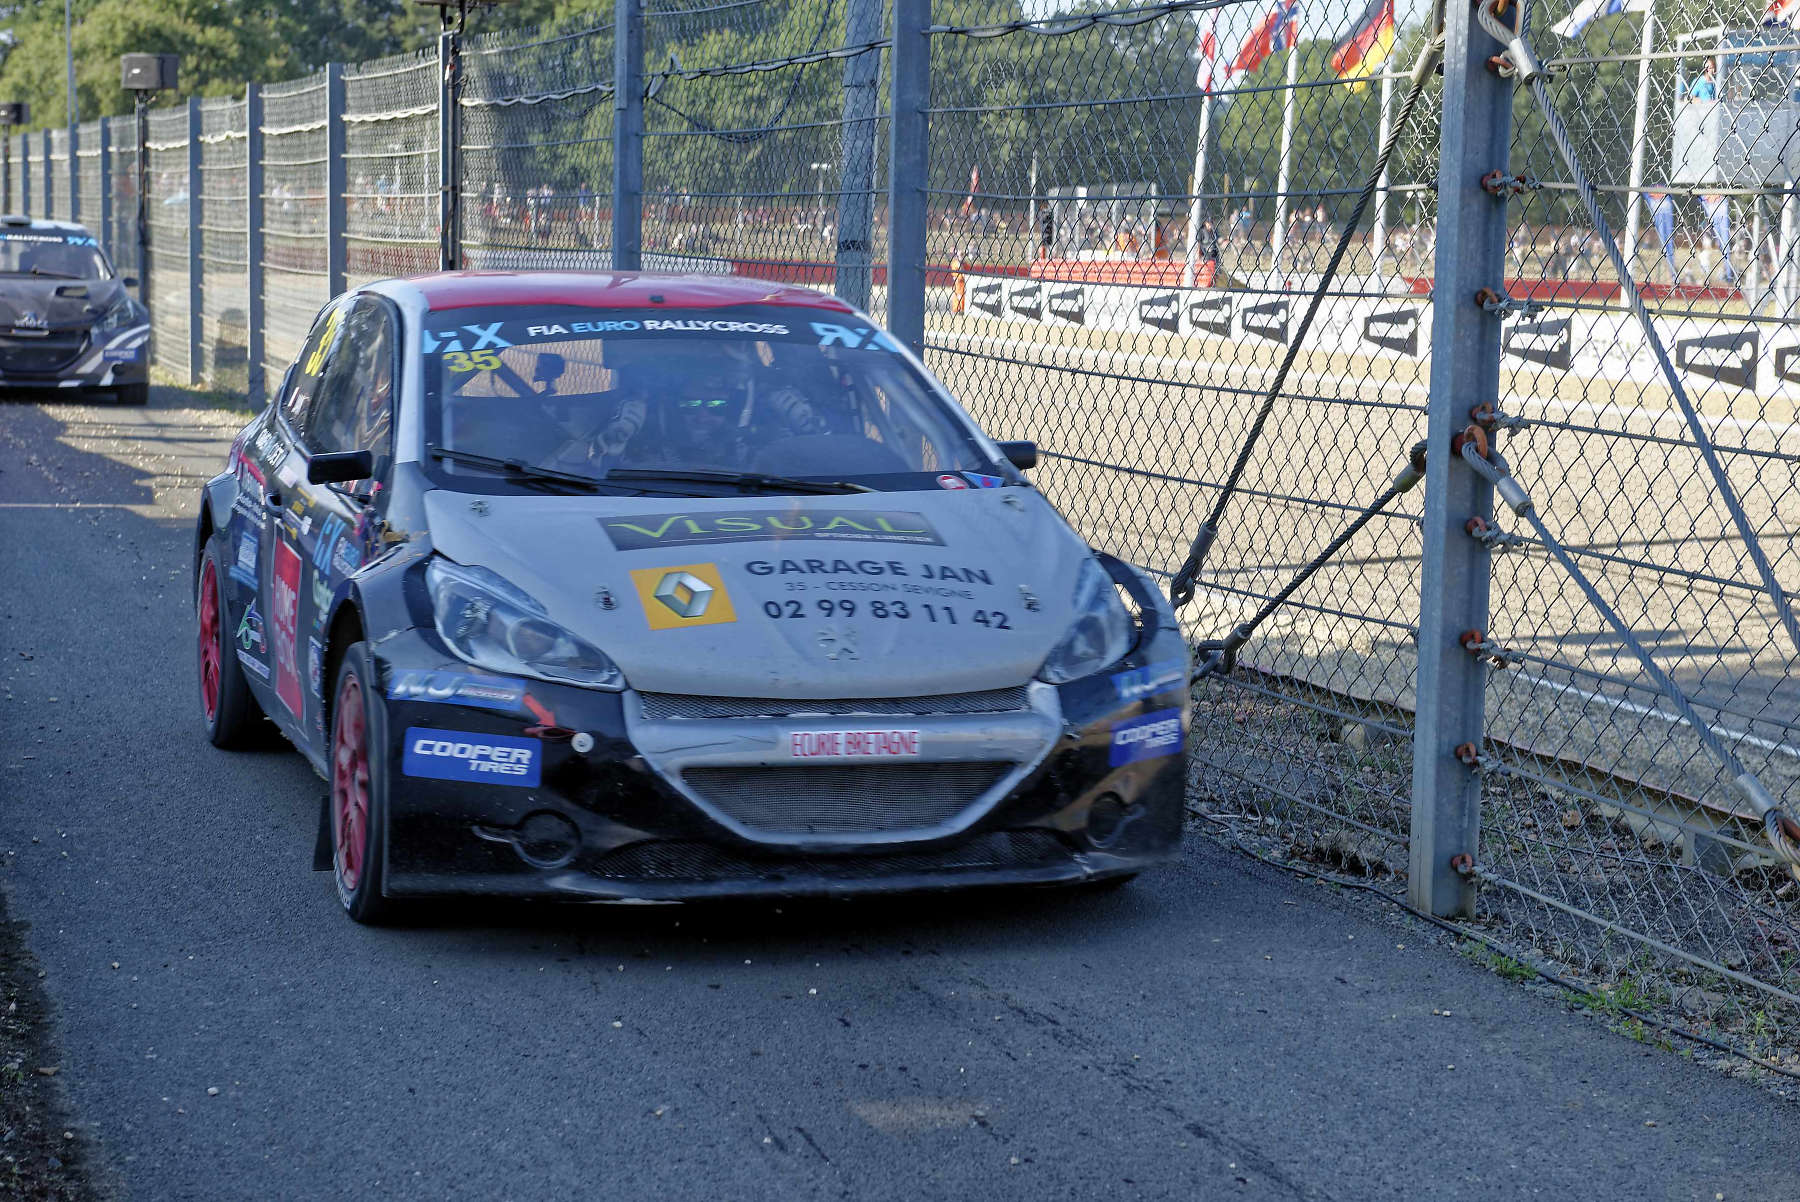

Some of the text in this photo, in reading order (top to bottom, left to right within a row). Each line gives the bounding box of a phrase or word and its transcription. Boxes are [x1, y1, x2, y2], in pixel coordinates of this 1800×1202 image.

[527, 320, 790, 336] FIA EURO RALLYCROSS
[443, 350, 502, 373] 35
[607, 516, 926, 538] VISUAL
[745, 559, 993, 586] GARAGE JAN
[787, 581, 808, 592] 35
[825, 581, 897, 592] CESSON
[763, 599, 1013, 631] 02 99 83 11 42
[413, 739, 533, 765] COOPER
[792, 731, 920, 756] ECURIE BRETAGNE
[468, 759, 529, 776] TIRES
